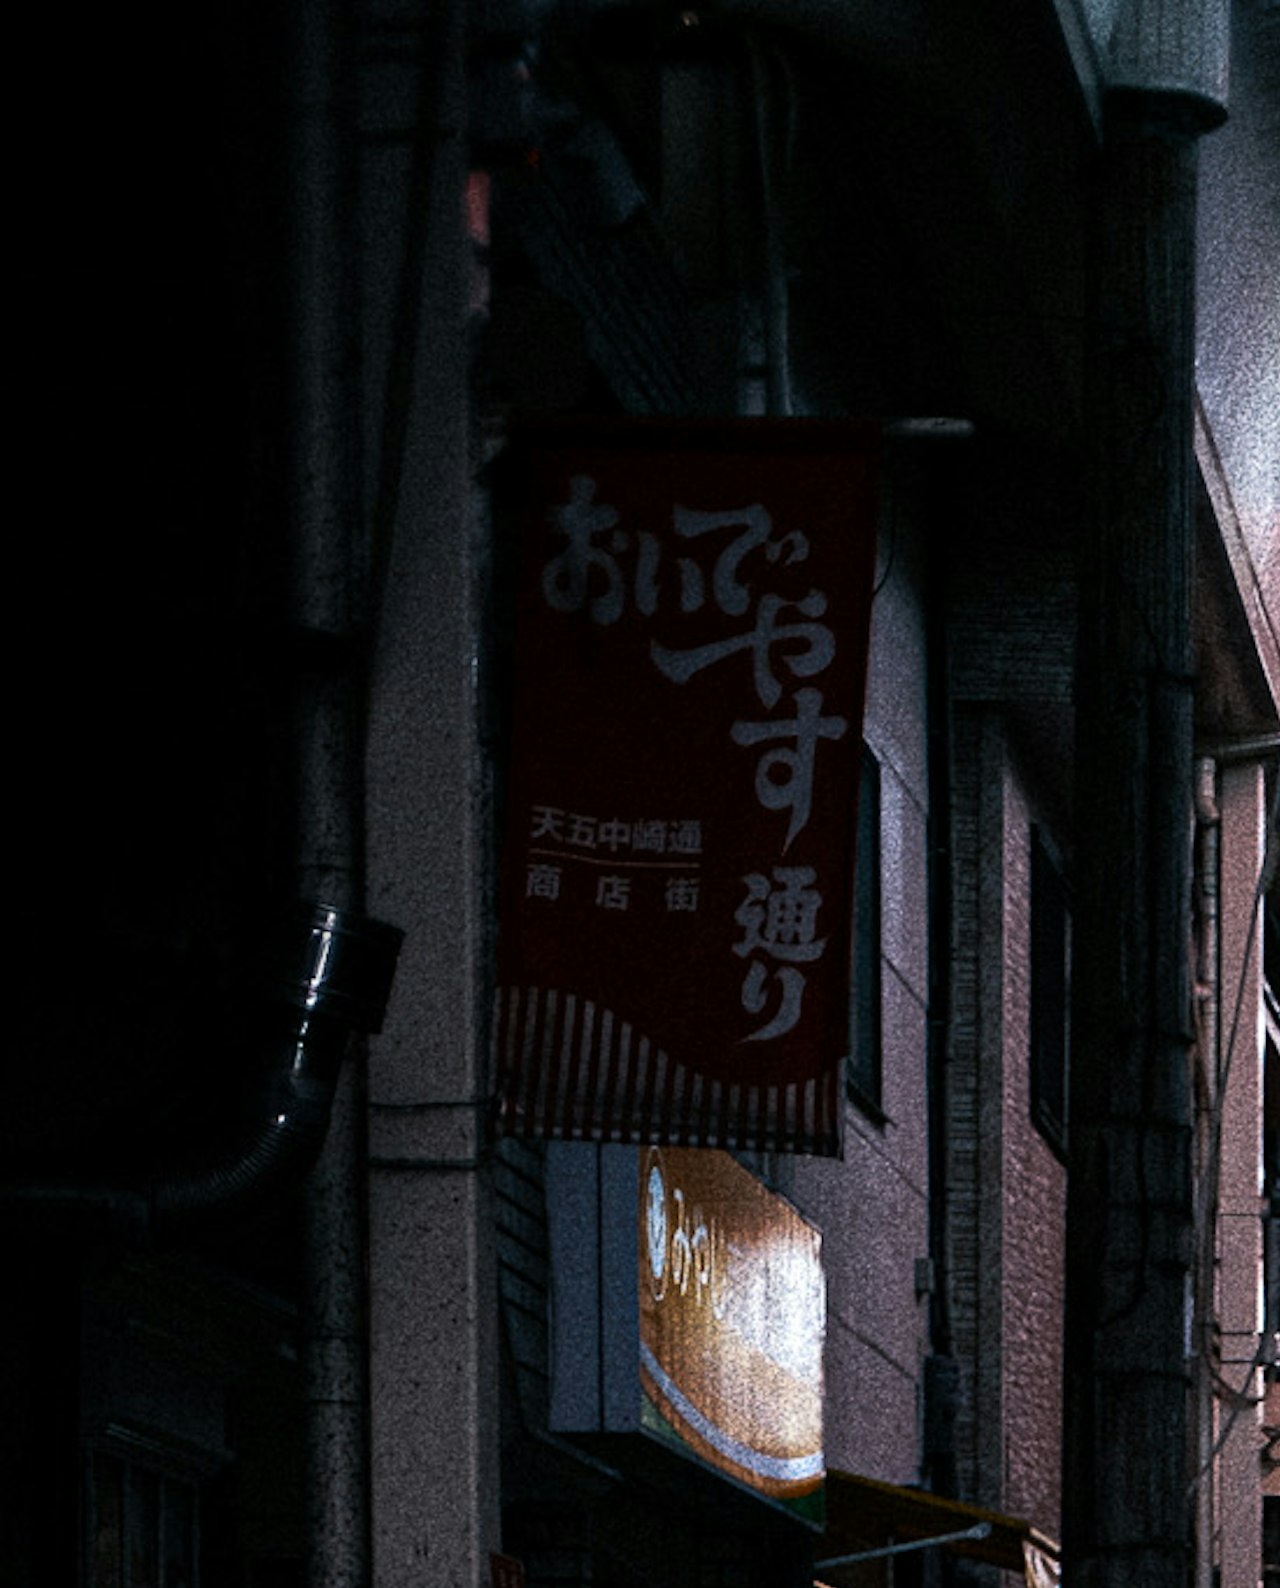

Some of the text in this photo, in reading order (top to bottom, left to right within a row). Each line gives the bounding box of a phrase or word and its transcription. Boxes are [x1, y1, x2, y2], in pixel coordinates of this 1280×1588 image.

[531, 806, 704, 854] 天五中崎通
